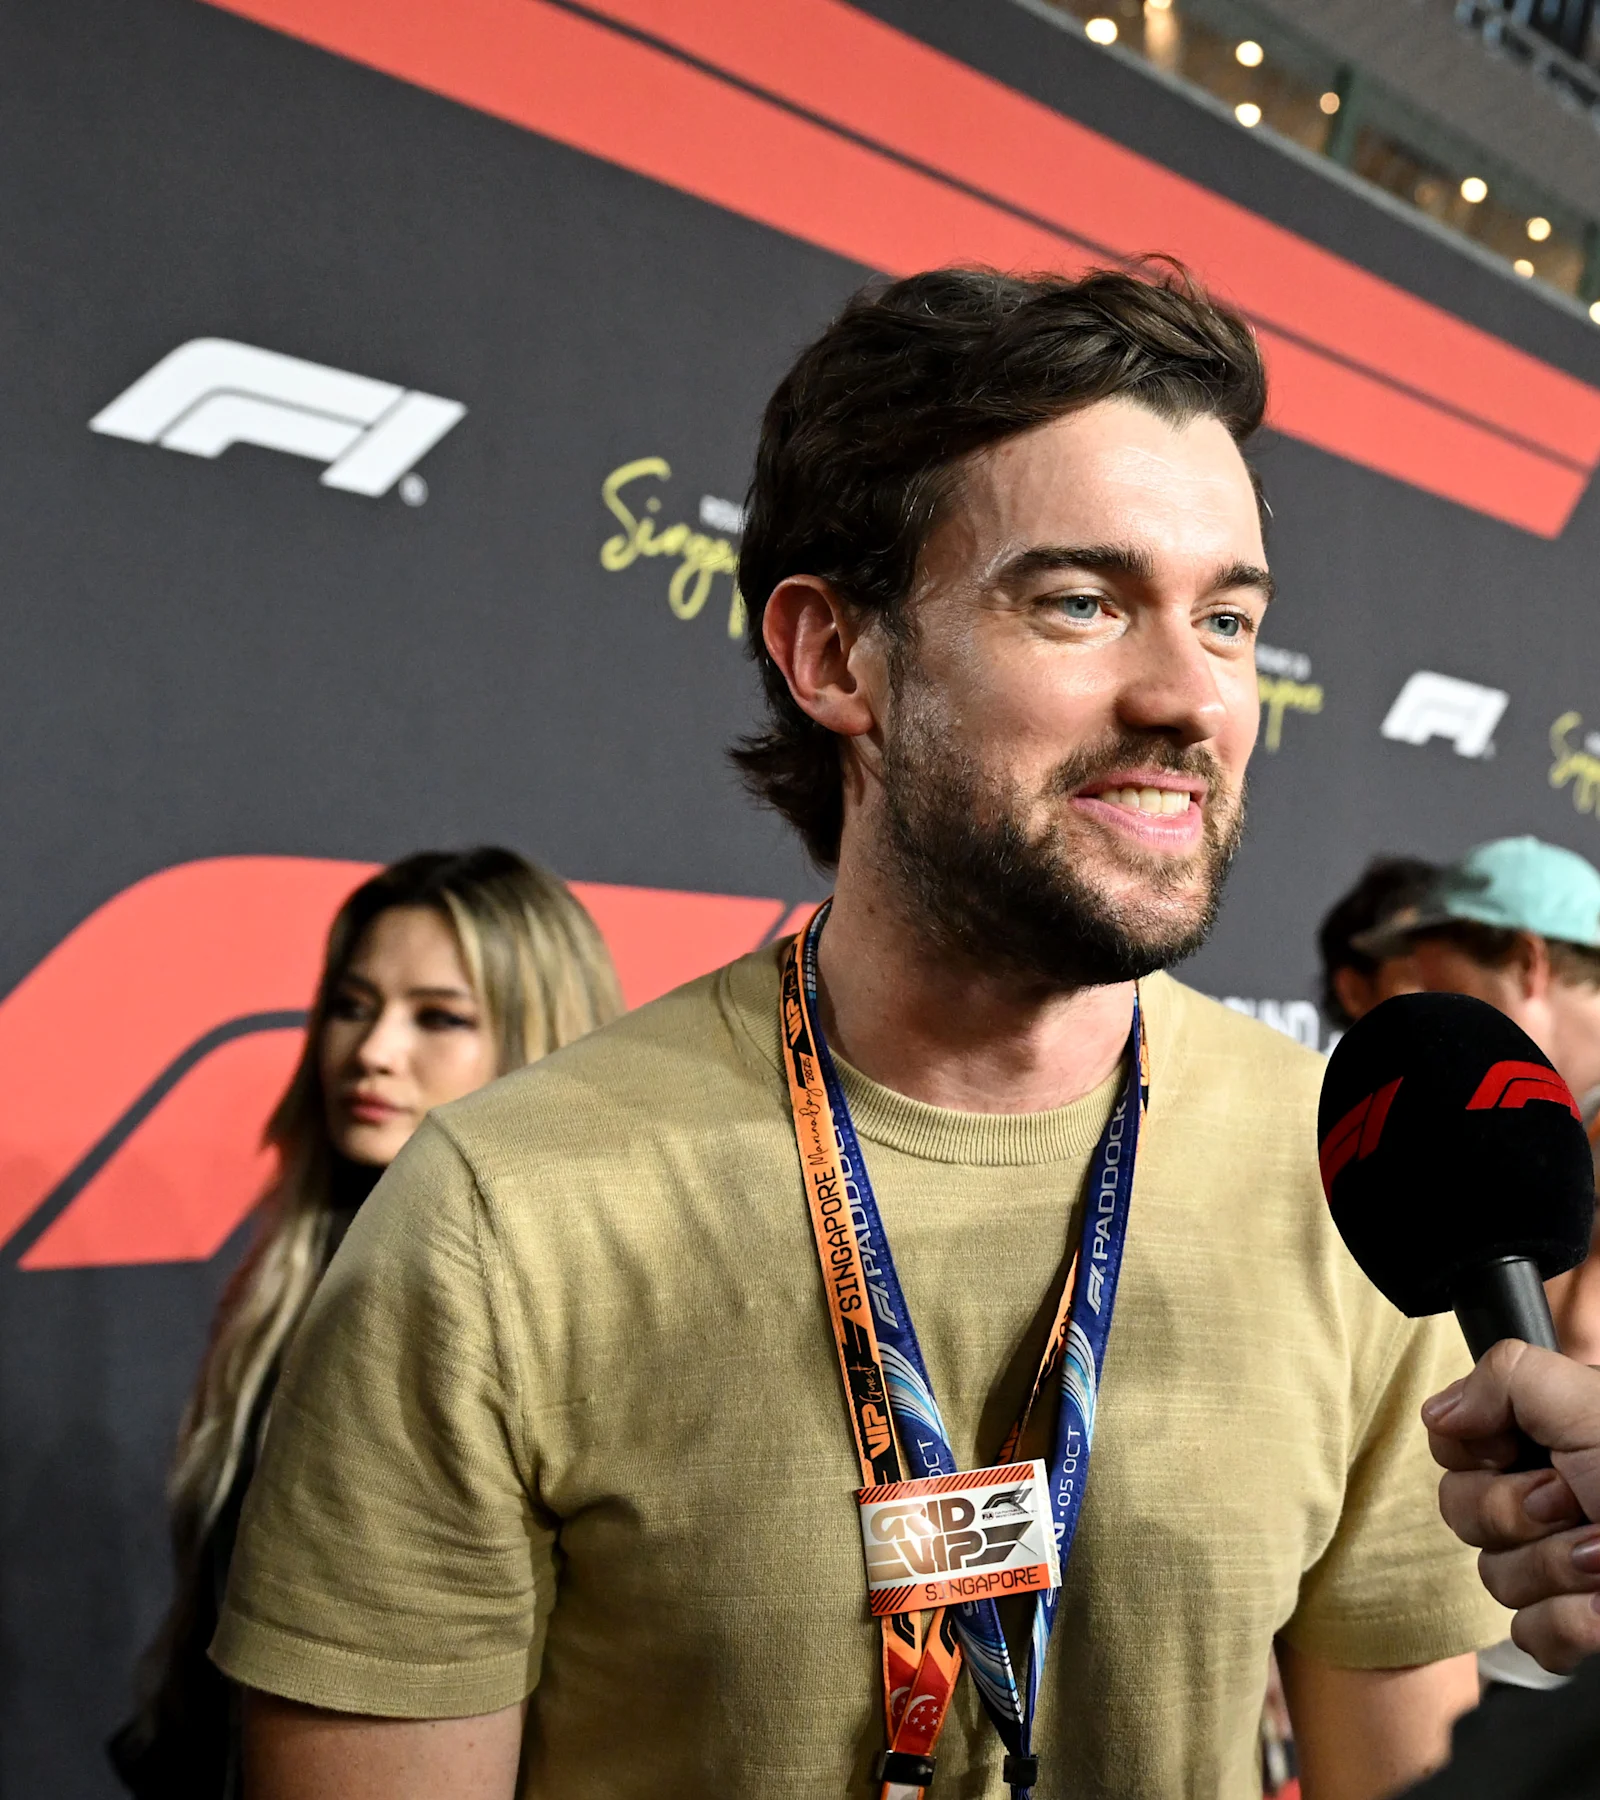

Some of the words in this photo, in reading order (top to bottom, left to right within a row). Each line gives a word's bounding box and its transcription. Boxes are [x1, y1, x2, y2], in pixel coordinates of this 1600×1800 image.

[88, 337, 468, 498] F1
[803, 1057, 815, 1084] 2025
[807, 1115, 829, 1166] Marina
[1092, 1102, 1127, 1261] PADDOCK
[815, 1167, 862, 1312] SINGAPORE
[867, 1283, 899, 1329] F1
[1087, 1262, 1105, 1316] F1
[861, 1403, 891, 1460] VIP
[1062, 1424, 1081, 1475] OCT
[891, 1531, 983, 1575] VIP
[925, 1566, 1041, 1601] SINGAPORE
